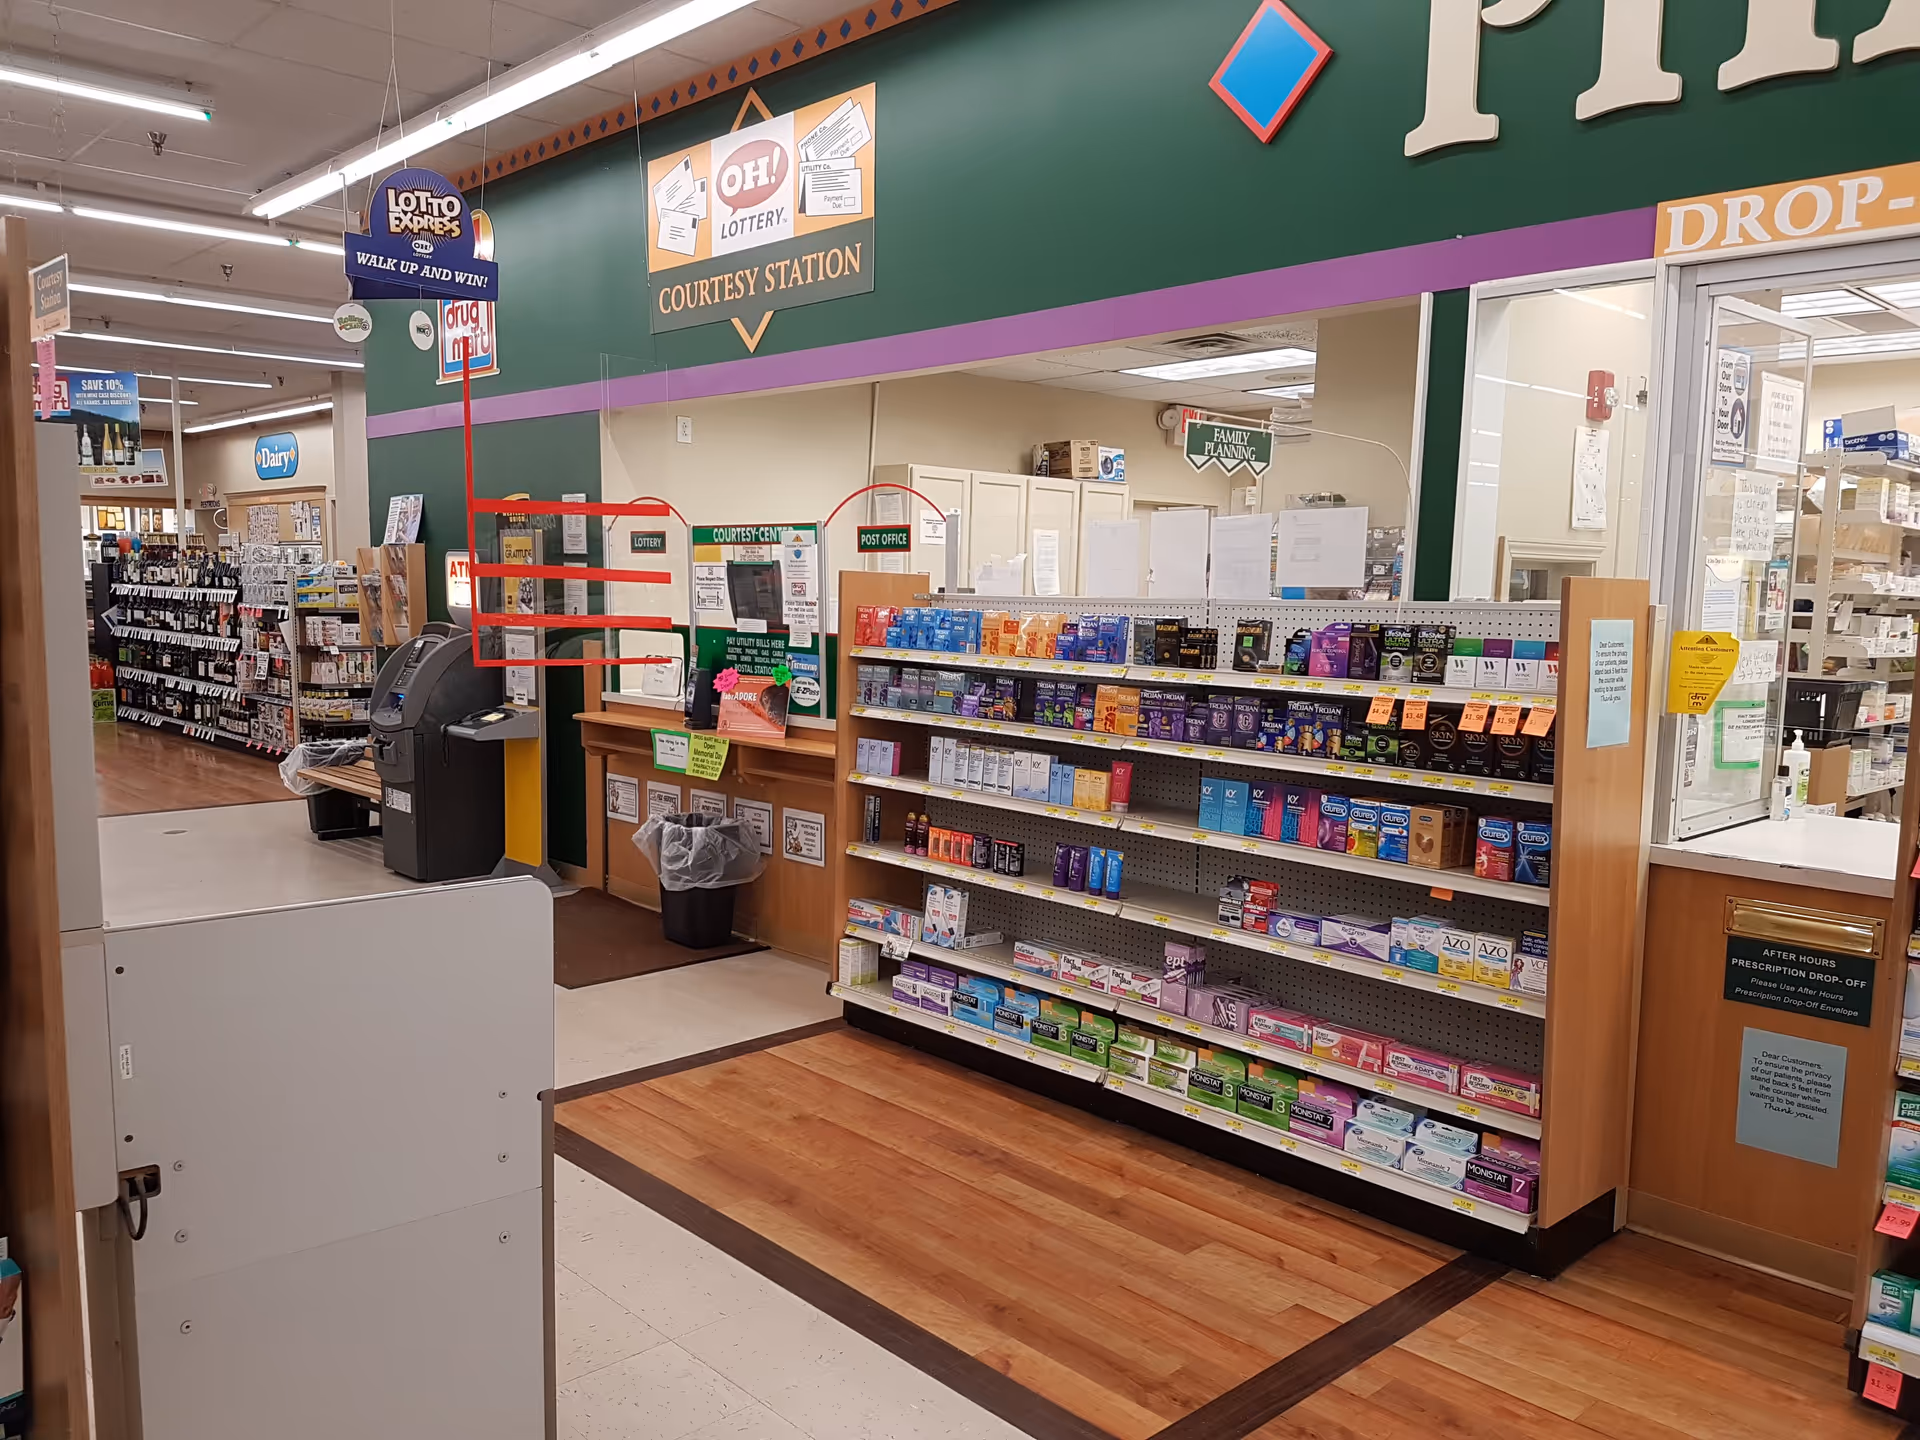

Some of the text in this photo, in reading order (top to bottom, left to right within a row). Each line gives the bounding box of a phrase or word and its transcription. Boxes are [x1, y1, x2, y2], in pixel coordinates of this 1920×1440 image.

[720, 146, 781, 198] OH!
[801, 164, 822, 172] UTILITY
[386, 187, 462, 219] LOTTO
[823, 195, 843, 204] Payment
[1663, 175, 1915, 254] DROP-
[386, 210, 462, 239] EXPRESS
[720, 206, 785, 240] LOTTERY
[356, 251, 489, 288] WALK UP AND WIN!
[36, 270, 64, 291] Courtesy
[658, 241, 863, 315] COURTESY STATION
[1721, 370, 1732, 381] Our
[81, 378, 124, 391] SAVE 10%
[1719, 382, 1732, 394] Store
[1721, 396, 1728, 406] To
[1716, 419, 1730, 430] Door
[1213, 427, 1251, 446] FAMILY
[261, 444, 290, 472] Dairy
[1203, 441, 1257, 461] PLANNING
[634, 537, 662, 548] LOTTERY
[860, 532, 908, 546] POST OFFICE
[1384, 630, 1412, 639] LifeStyles
[1418, 631, 1446, 640] LifeStyles
[736, 637, 755, 646] UTILITY
[755, 639, 770, 647] BILLS
[771, 639, 785, 649] HERE
[1208, 702, 1233, 711] TROJAN
[1234, 704, 1259, 713] TROJAN
[1287, 702, 1314, 712] TROJAN
[1464, 713, 1484, 722] $1.98
[1496, 717, 1517, 725] $1.98
[1431, 730, 1454, 740] SKYN
[1464, 733, 1488, 742] SKYN
[1500, 736, 1524, 746] SKYN
[703, 741, 716, 750] Open
[693, 747, 714, 760] Memorial
[1322, 803, 1347, 816] durex
[1352, 808, 1376, 822] durex
[1383, 812, 1408, 824] durex
[1481, 829, 1509, 842] durex
[1519, 832, 1549, 845] durex
[1441, 934, 1471, 951] AZO
[1477, 941, 1508, 959] AZO
[1063, 953, 1075, 966] Fact
[1165, 954, 1186, 970] ept
[1762, 948, 1837, 968] AFTER HOURS
[1070, 962, 1082, 974] plus
[1111, 969, 1124, 981] Fact
[1731, 957, 1807, 978] PRESCRIPTION
[1845, 978, 1867, 989] OFF
[1119, 976, 1132, 988] plus
[1750, 977, 1844, 1001] Please Use After Hours
[952, 990, 978, 1005] MONISTAT
[1734, 986, 1859, 1017] Prescription Drop-Off Envelope
[994, 1007, 1018, 1023] MONISTAT
[1227, 1002, 1237, 1029] ept
[1032, 1019, 1058, 1034] MONISTAT
[1059, 1029, 1068, 1041] 3
[1072, 1031, 1097, 1046] MONISTAT
[1097, 1041, 1105, 1055] 3
[1761, 1050, 1780, 1060] Dear
[1391, 1054, 1406, 1063] FIRST
[1419, 1066, 1435, 1076] DAYS
[1753, 1056, 1832, 1082] To ensure the privacy
[1189, 1070, 1221, 1089] MONISTAT
[1468, 1079, 1491, 1090] RESPONSE
[1469, 1074, 1484, 1084] FIRST
[1750, 1074, 1771, 1084] stand
[1772, 1079, 1790, 1088] back
[1798, 1085, 1812, 1094] feet
[1814, 1088, 1831, 1097] from
[1806, 1078, 1832, 1089] please
[1224, 1083, 1234, 1098] 3
[1239, 1086, 1272, 1104] MONISTAT
[1498, 1086, 1515, 1097] DAYS
[1749, 1090, 1775, 1103] waiting
[1776, 1096, 1784, 1104] to
[1758, 1084, 1821, 1104] the counter while
[1275, 1100, 1286, 1114] 3
[1290, 1103, 1333, 1125] MONISTAT 7
[1763, 1101, 1795, 1115] Thank
[1467, 1161, 1508, 1183] MONISTAT
[1514, 1178, 1526, 1193] 7
[1885, 1214, 1912, 1228] $7.99
[1870, 1378, 1898, 1393] $1.99
